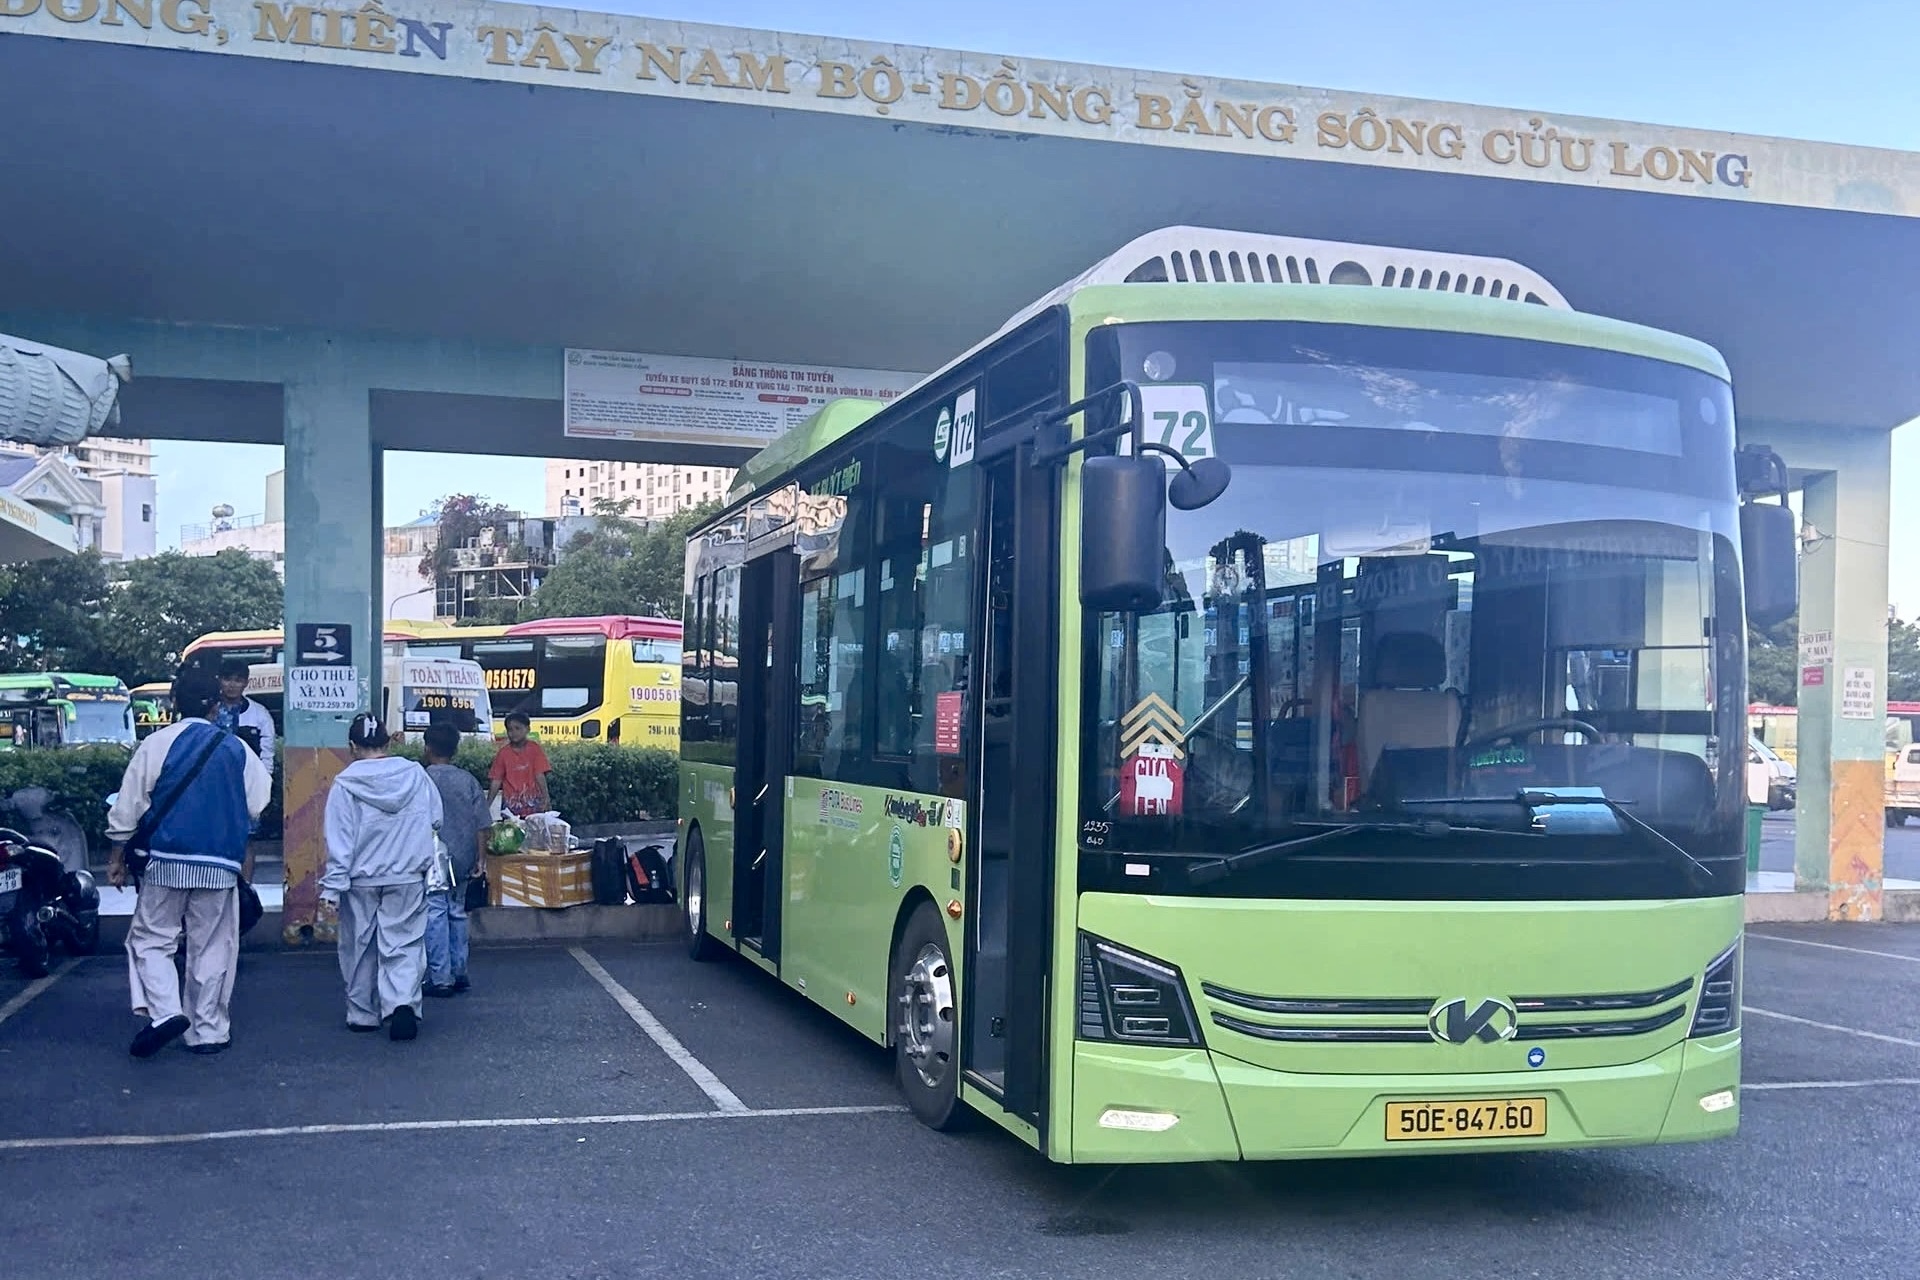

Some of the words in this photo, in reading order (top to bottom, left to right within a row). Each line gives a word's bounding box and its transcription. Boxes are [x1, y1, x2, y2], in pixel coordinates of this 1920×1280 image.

[477, 21, 613, 74] TÂY
[637, 42, 791, 94] NAM
[1134, 78, 1298, 143] BẰNG
[1317, 107, 1466, 160] SÔNG
[1481, 117, 1596, 173] CỬU
[1609, 141, 1752, 187] LONG
[790, 371, 804, 382] TIN
[954, 410, 974, 457] 172
[1141, 410, 1207, 456] 72
[314, 627, 337, 648] 5
[291, 668, 319, 681] CHO
[321, 665, 355, 681] THUÊ
[482, 669, 536, 689] 0561579
[320, 682, 347, 697] MÁY
[422, 697, 447, 709] 1900
[1400, 1105, 1533, 1133] 50E-847.60
